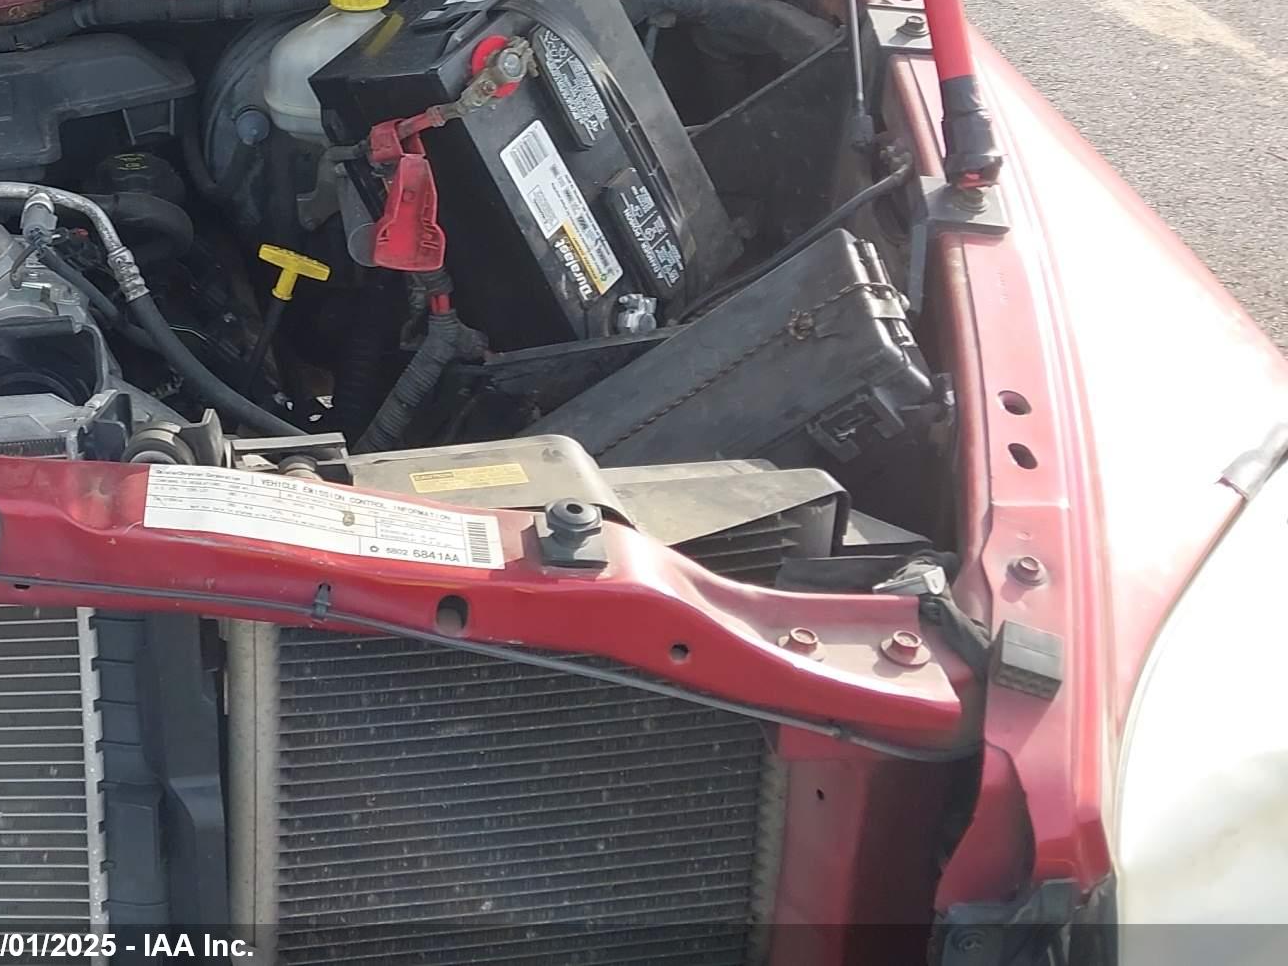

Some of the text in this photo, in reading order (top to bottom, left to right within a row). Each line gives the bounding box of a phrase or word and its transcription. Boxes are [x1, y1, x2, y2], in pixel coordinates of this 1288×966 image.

[554, 238, 594, 301] Duralast
[261, 479, 297, 490] VEHICLE
[303, 486, 345, 501] EMISSION
[349, 497, 387, 509] CONTROL
[393, 505, 451, 520] INFORMATION
